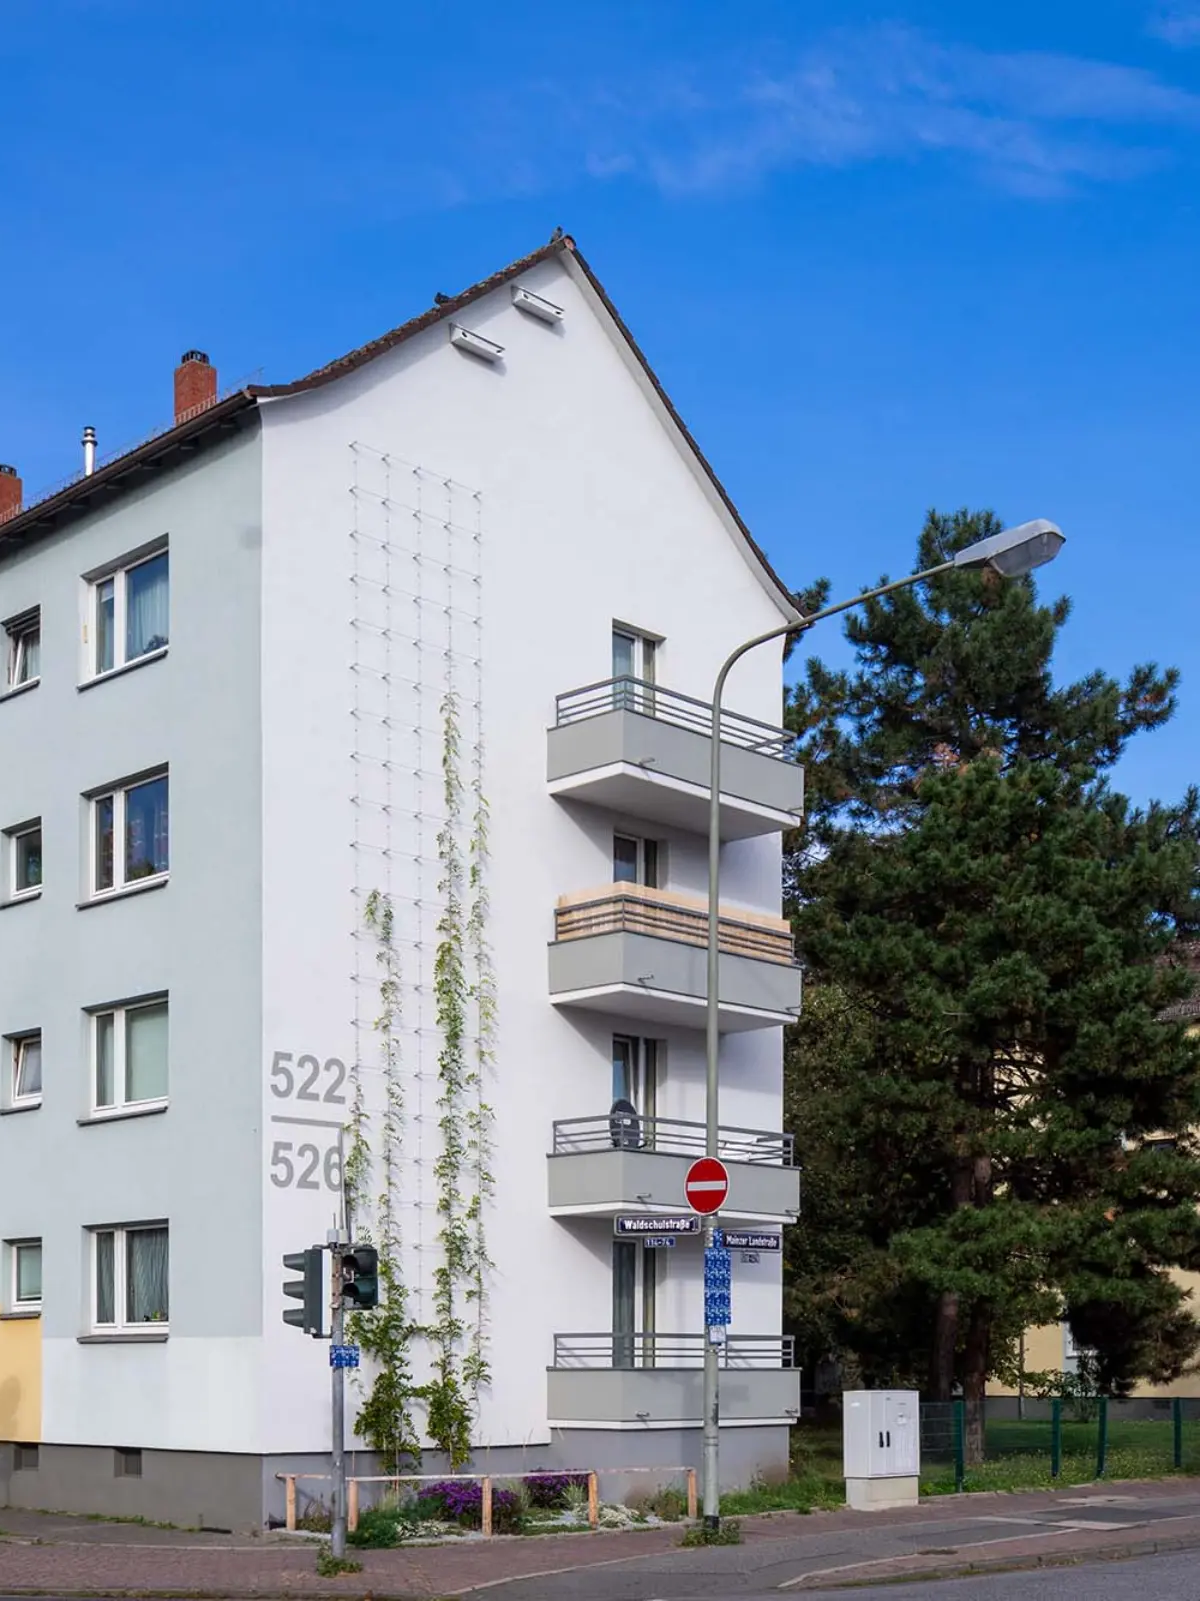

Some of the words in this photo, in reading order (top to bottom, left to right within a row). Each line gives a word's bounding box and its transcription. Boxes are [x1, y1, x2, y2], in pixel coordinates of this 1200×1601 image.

[270, 1051, 346, 1105] 522
[270, 1141, 342, 1192] 526
[624, 1219, 690, 1231] Waldschulstraße
[726, 1234, 747, 1245] Mainzer
[748, 1236, 778, 1248] Landstraße
